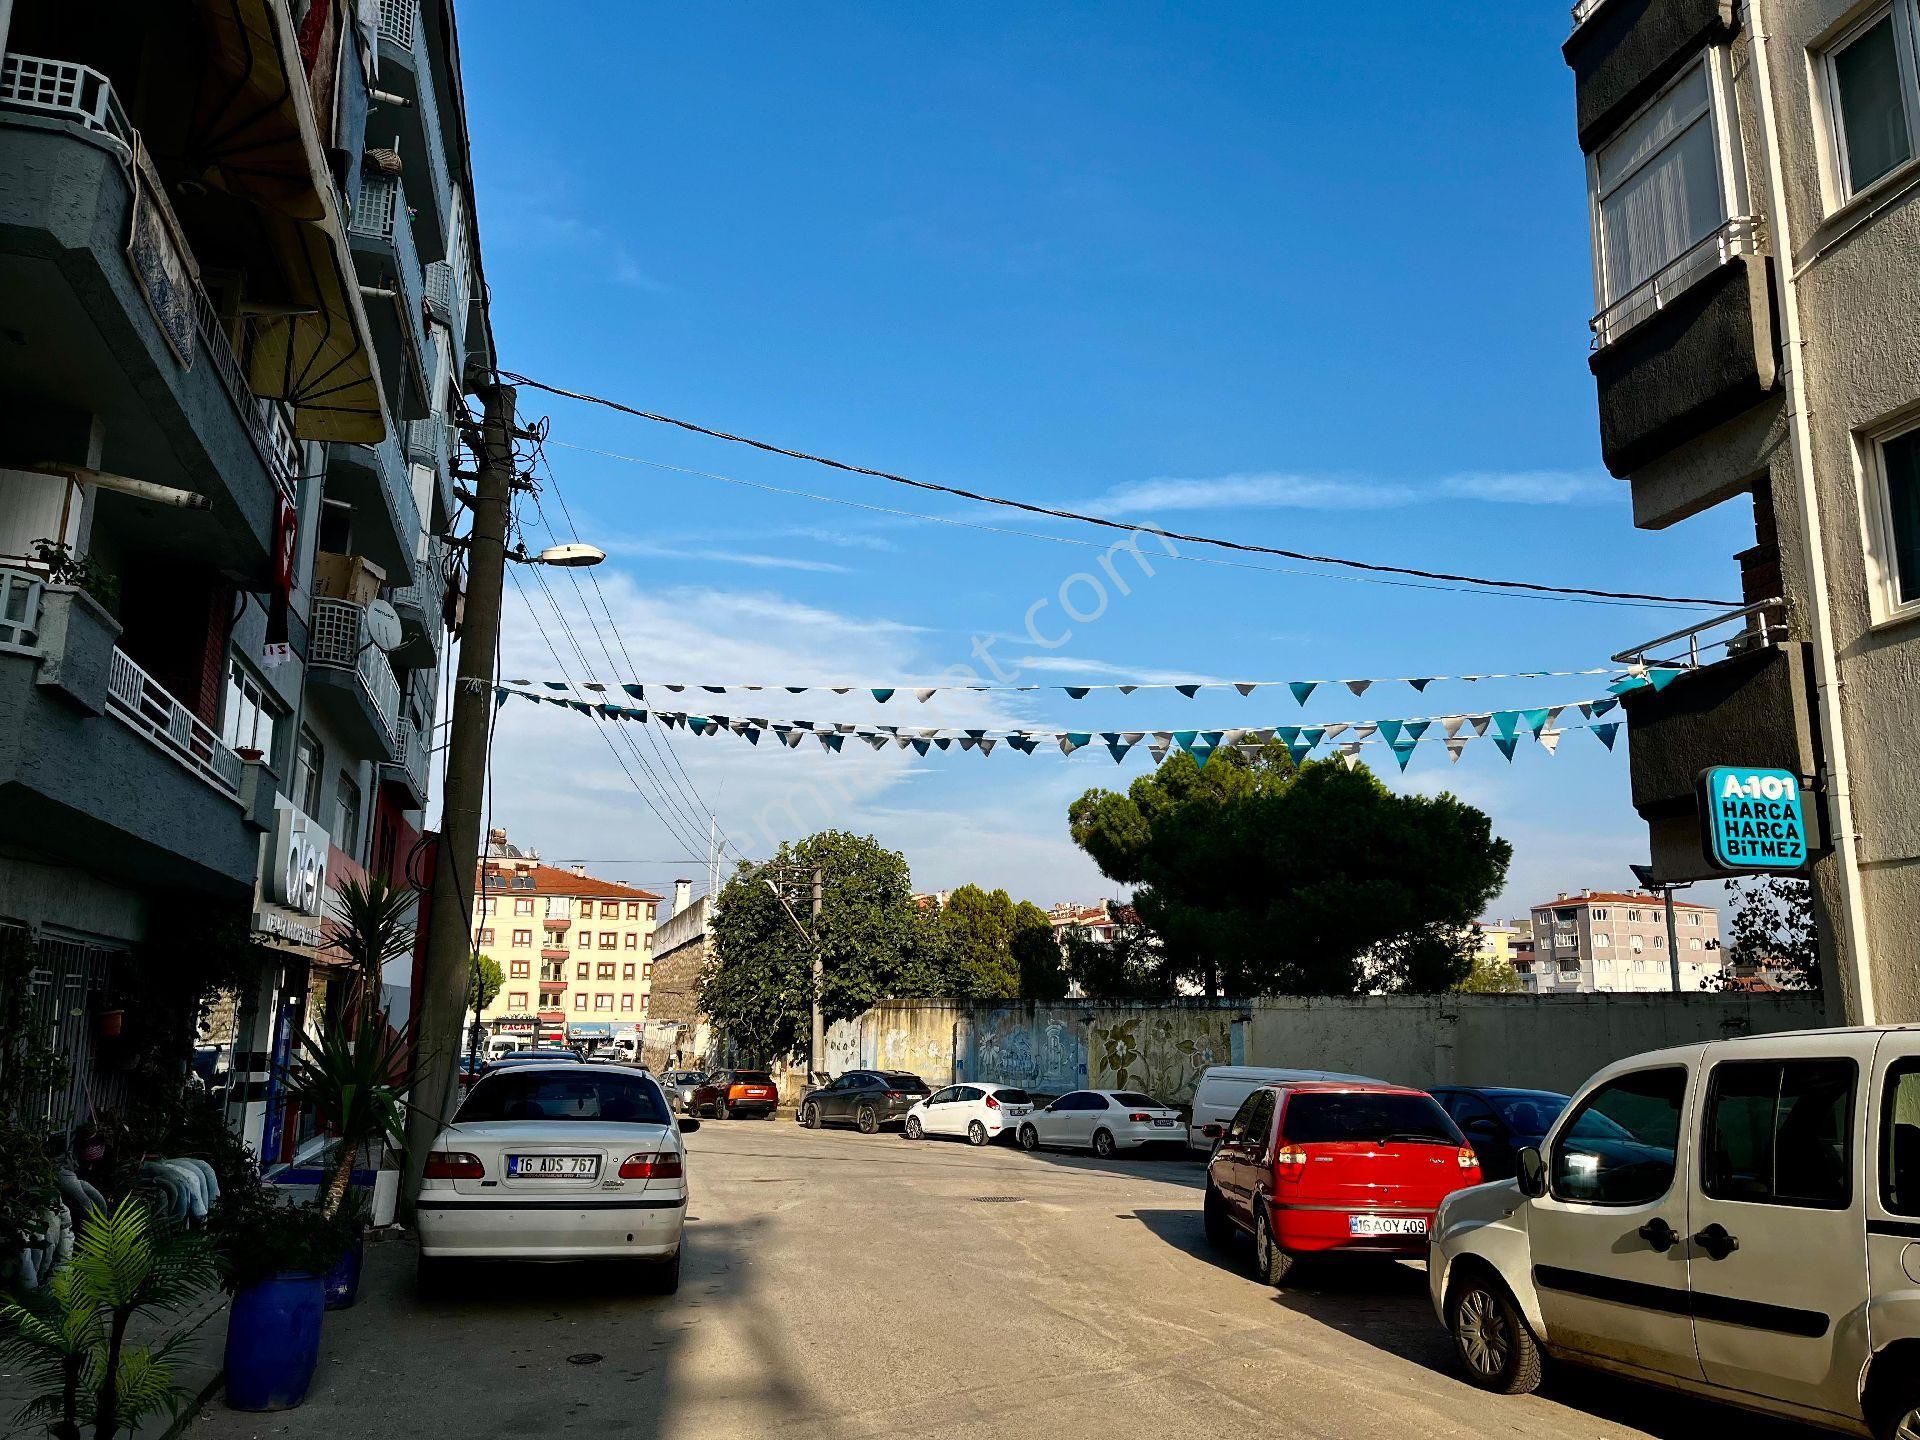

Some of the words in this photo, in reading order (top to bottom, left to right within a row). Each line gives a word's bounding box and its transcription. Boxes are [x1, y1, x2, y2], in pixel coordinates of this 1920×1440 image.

[1722, 801, 1797, 820] HARCA
[1725, 820, 1799, 840] HARCA
[519, 1158, 533, 1172] 16
[539, 1158, 564, 1172] ADS
[571, 1158, 595, 1173] 767
[1358, 1219, 1371, 1232] 16
[1402, 1220, 1425, 1234] 409
